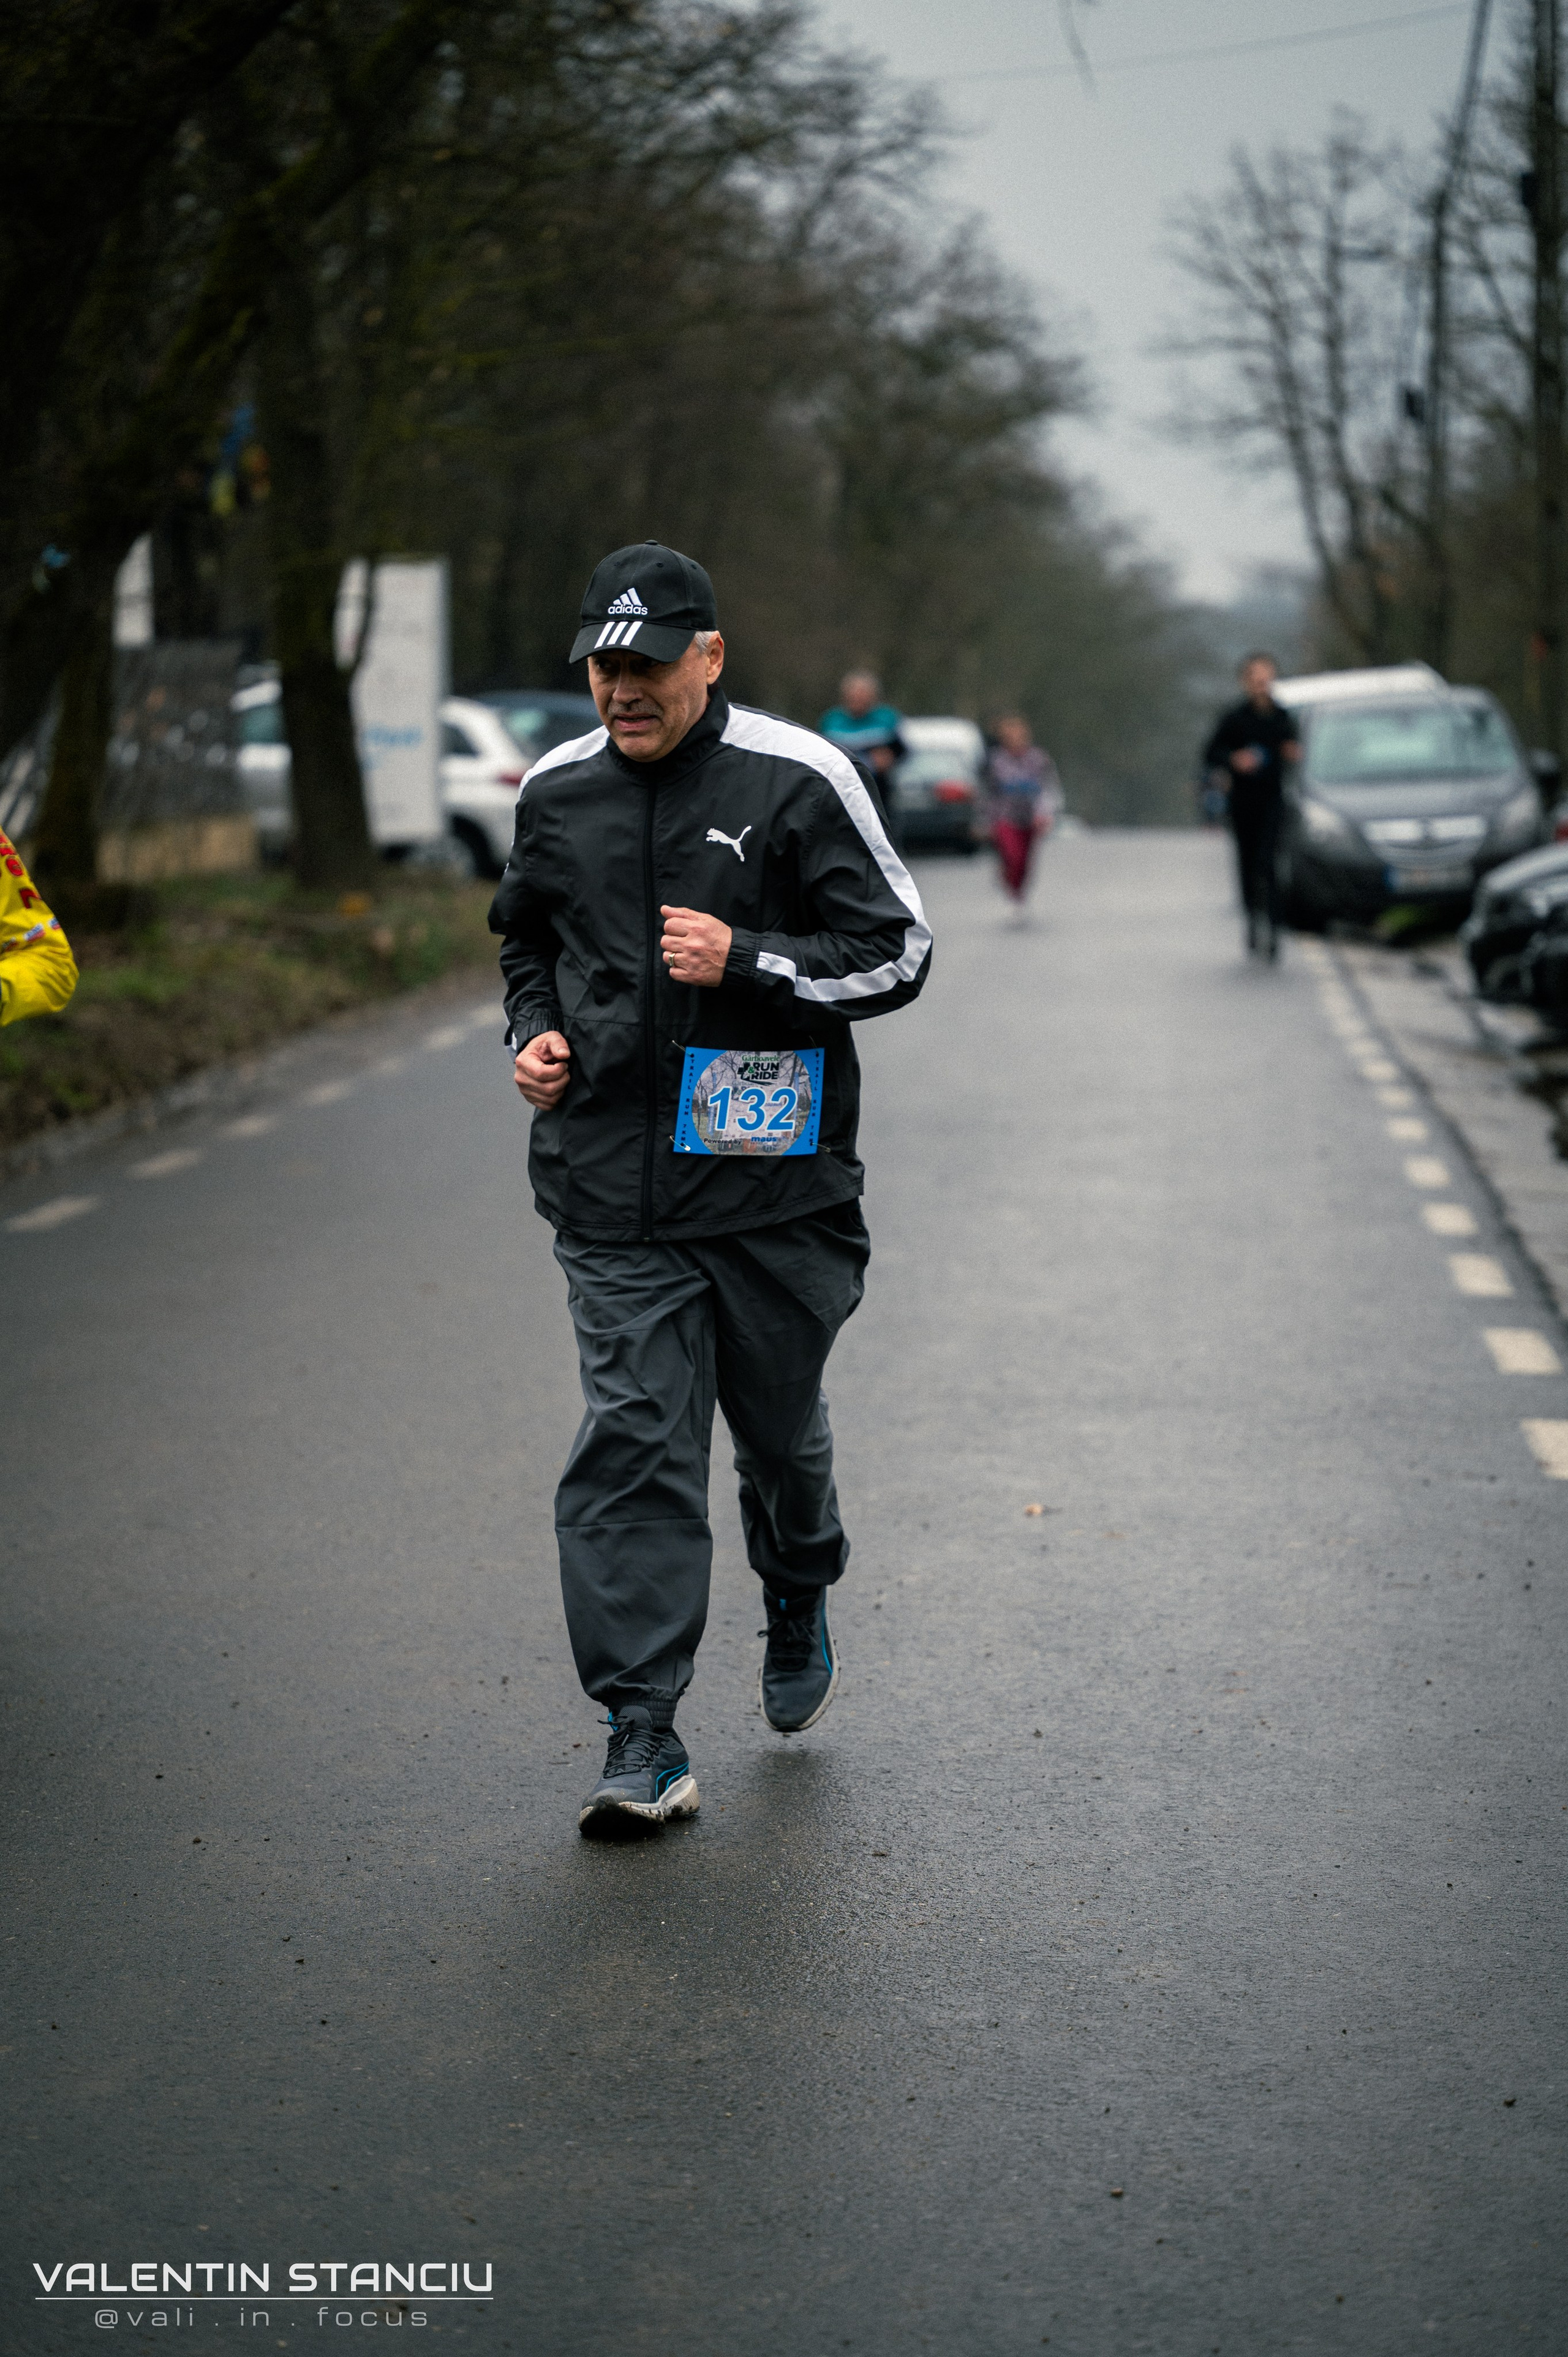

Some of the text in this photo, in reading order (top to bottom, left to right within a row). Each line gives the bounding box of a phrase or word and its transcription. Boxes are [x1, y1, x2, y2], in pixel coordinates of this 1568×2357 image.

[608, 604, 648, 615] adidas
[753, 1062, 780, 1071] RUN
[708, 1086, 797, 1132] 132
